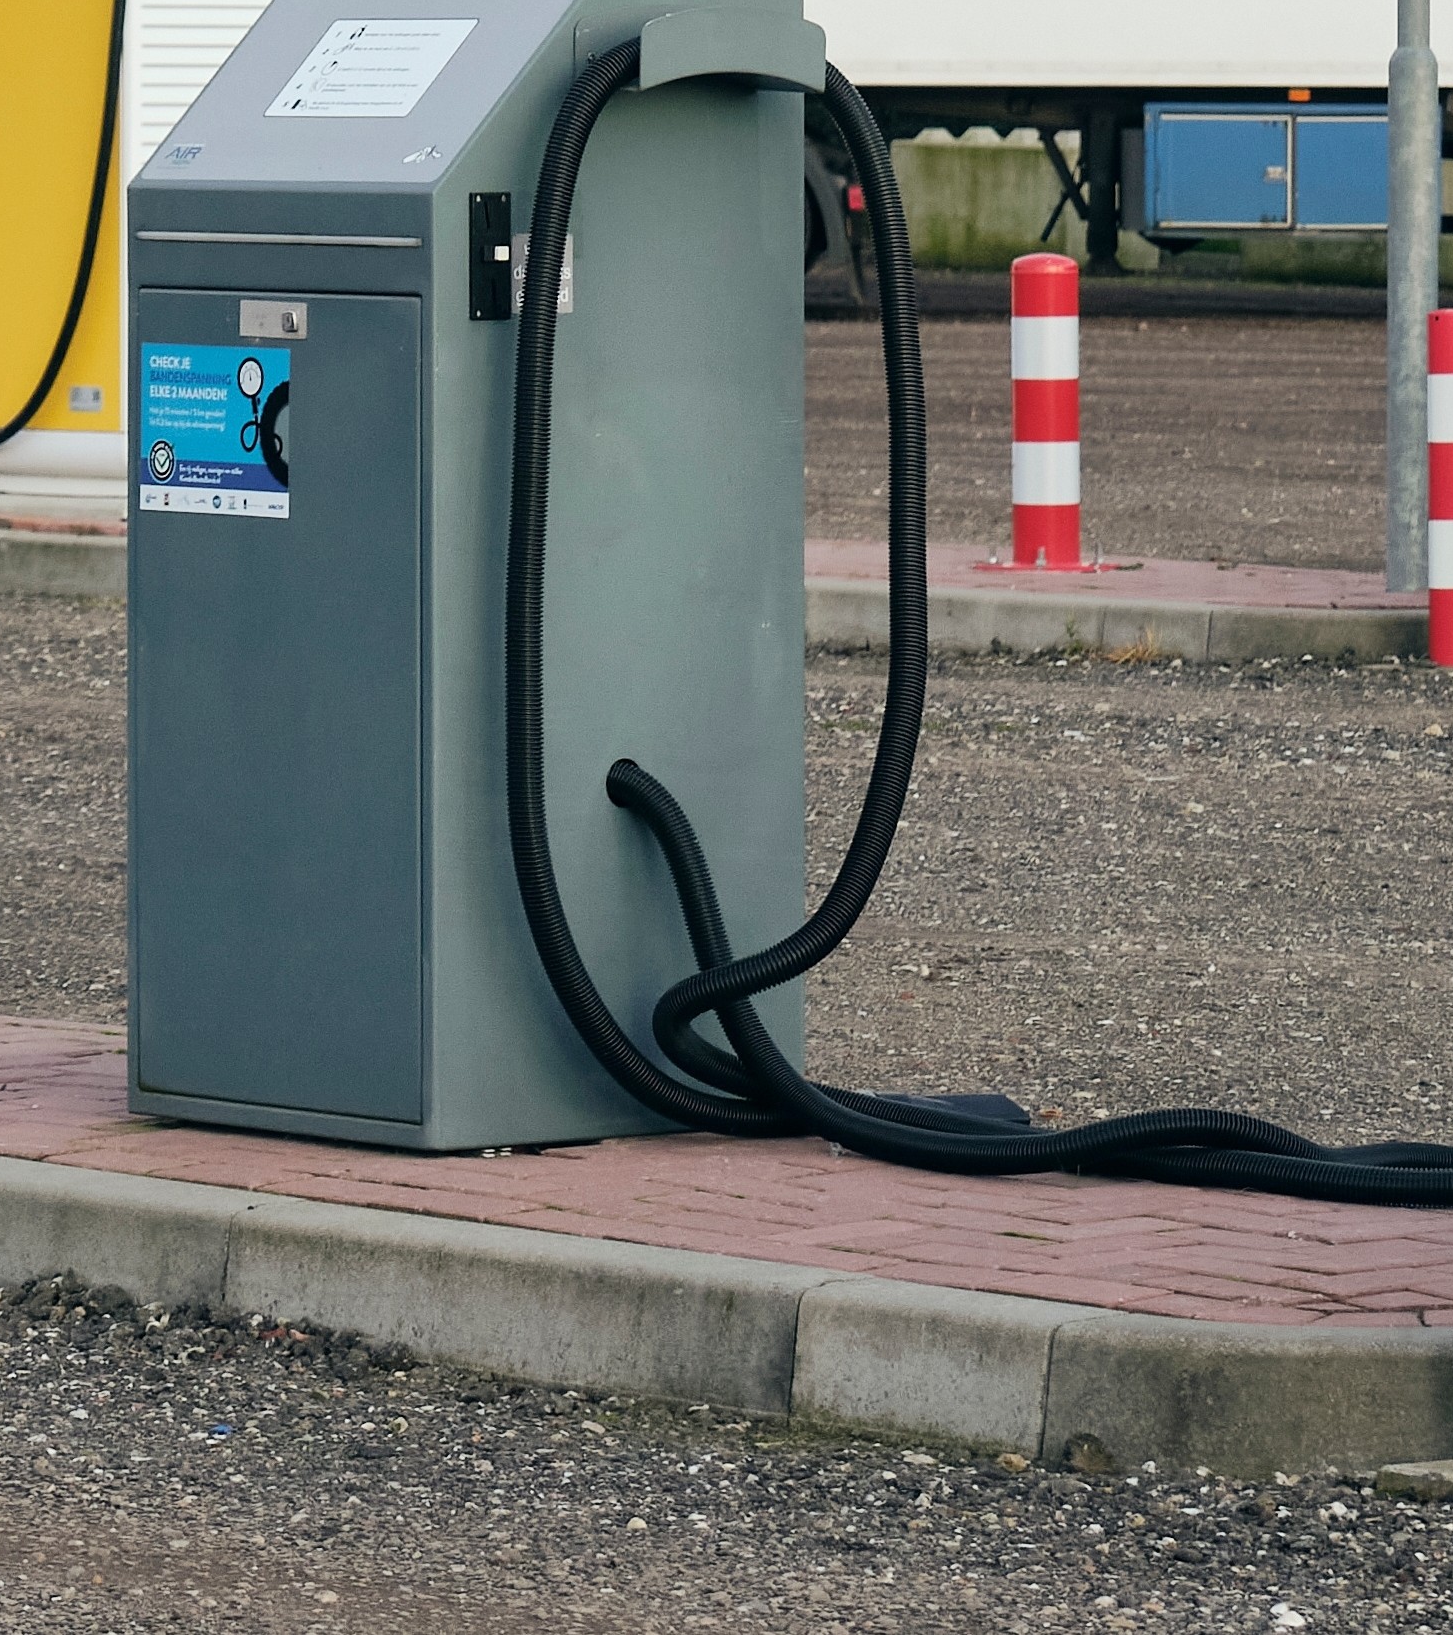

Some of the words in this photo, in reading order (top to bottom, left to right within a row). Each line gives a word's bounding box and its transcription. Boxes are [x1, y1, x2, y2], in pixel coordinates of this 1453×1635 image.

[164, 146, 203, 159] AIR
[149, 355, 181, 368] CHECK
[181, 356, 191, 370] JE
[149, 370, 232, 385] BANDENSPANNING
[149, 384, 170, 398] ELKE
[171, 385, 178, 399] 2
[178, 386, 228, 401] MAANDEN!
